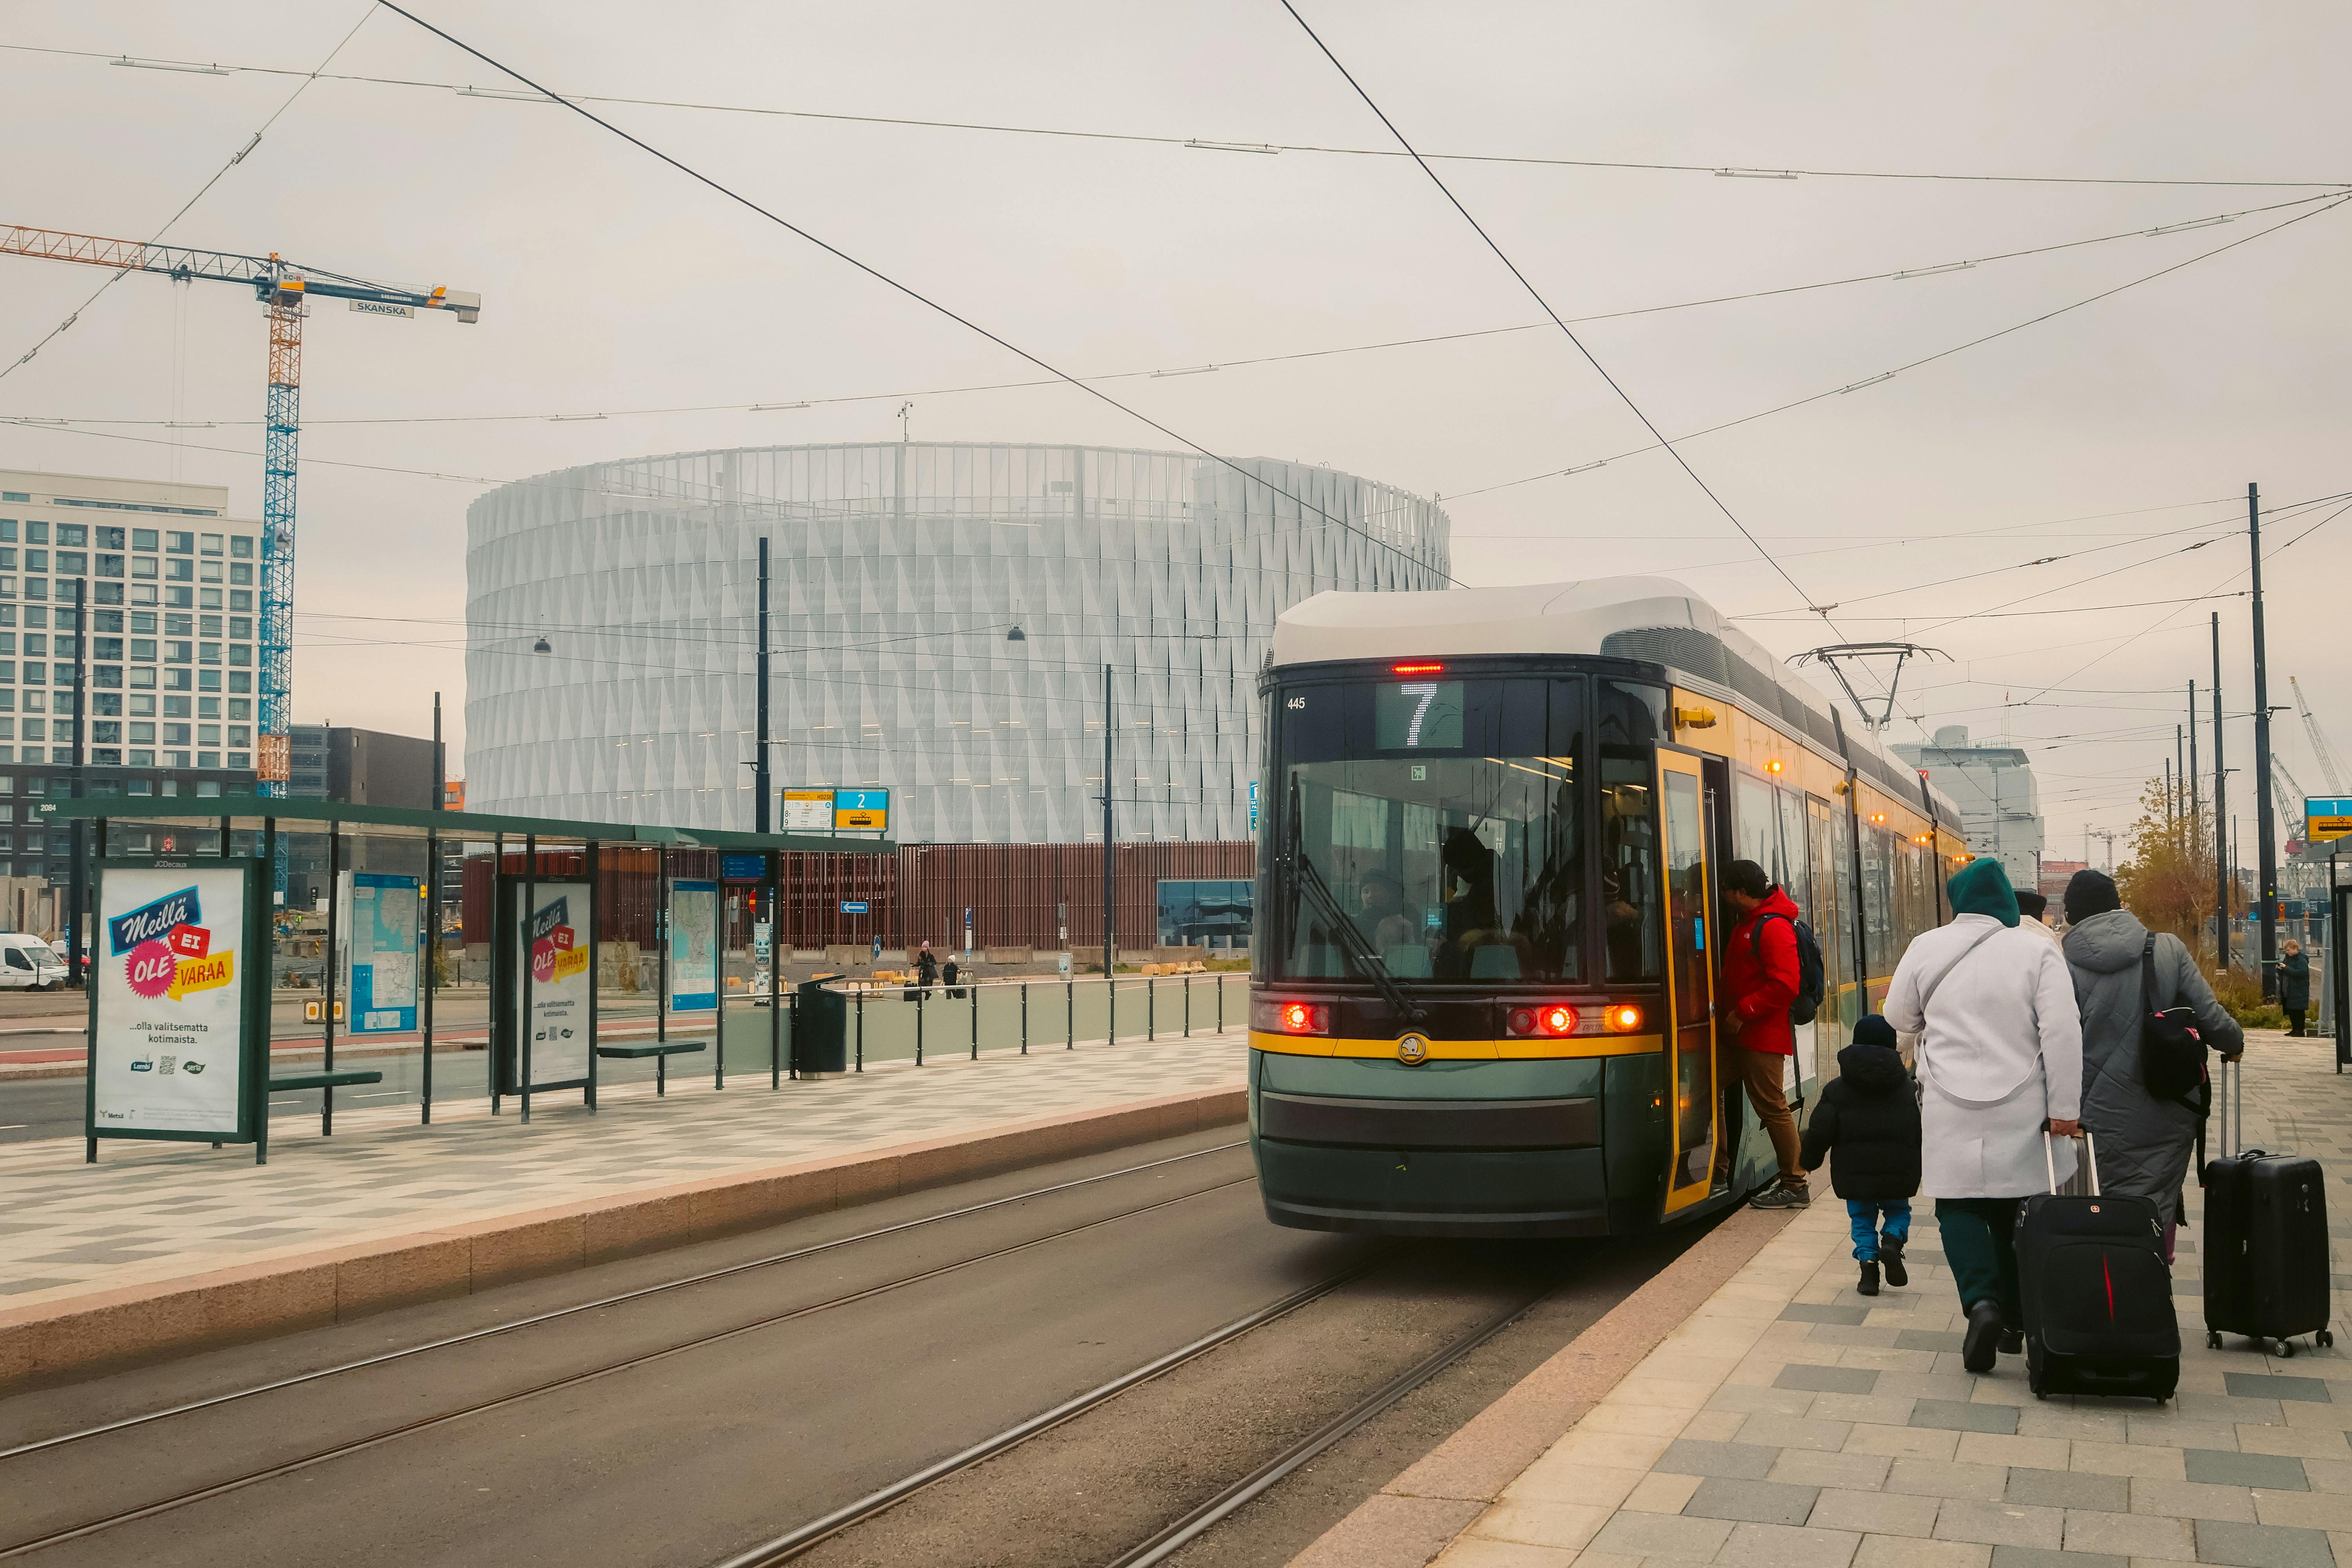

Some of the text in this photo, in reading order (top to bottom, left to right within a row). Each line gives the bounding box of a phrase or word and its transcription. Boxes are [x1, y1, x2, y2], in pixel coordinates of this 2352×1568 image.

[357, 303, 406, 316] SKANSKA
[1288, 697, 1305, 710] 445
[1401, 683, 1437, 746] 7
[858, 793, 865, 808] 2
[2332, 802, 2337, 815] 1
[122, 897, 188, 943] Meillä
[966, 908, 969, 919] P
[181, 933, 201, 950] EI
[558, 932, 569, 944] EI
[534, 949, 553, 971] OLE
[558, 952, 584, 973] VARAA
[134, 955, 171, 982] OLE
[180, 960, 225, 986] VARAA
[129, 1022, 208, 1032] ...olla valitsematta
[148, 1034, 198, 1044] kotimaista.
